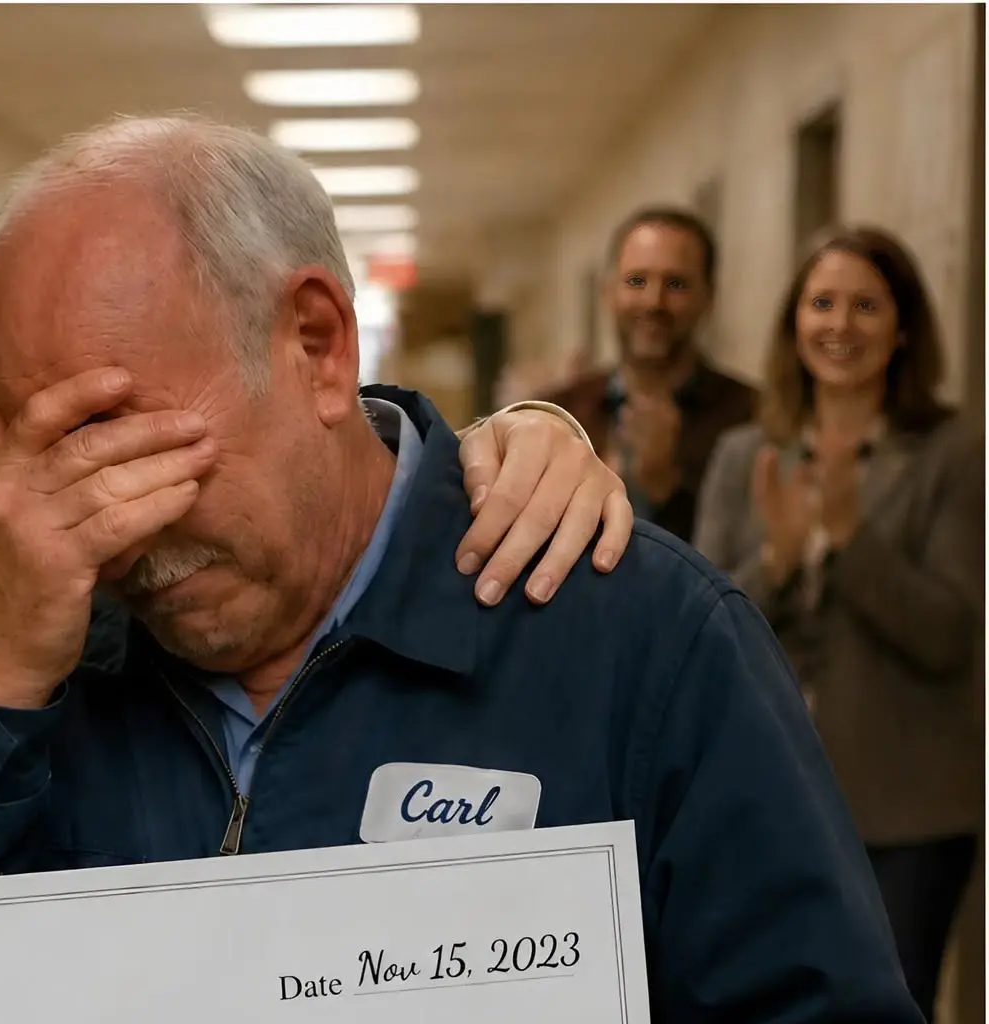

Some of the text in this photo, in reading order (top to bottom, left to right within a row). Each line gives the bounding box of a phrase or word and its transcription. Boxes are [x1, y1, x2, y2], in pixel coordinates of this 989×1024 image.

[400, 779, 501, 826] Carl
[279, 975, 343, 1001] Date
[430, 942, 473, 980] 15,
[487, 931, 581, 974] 2023
